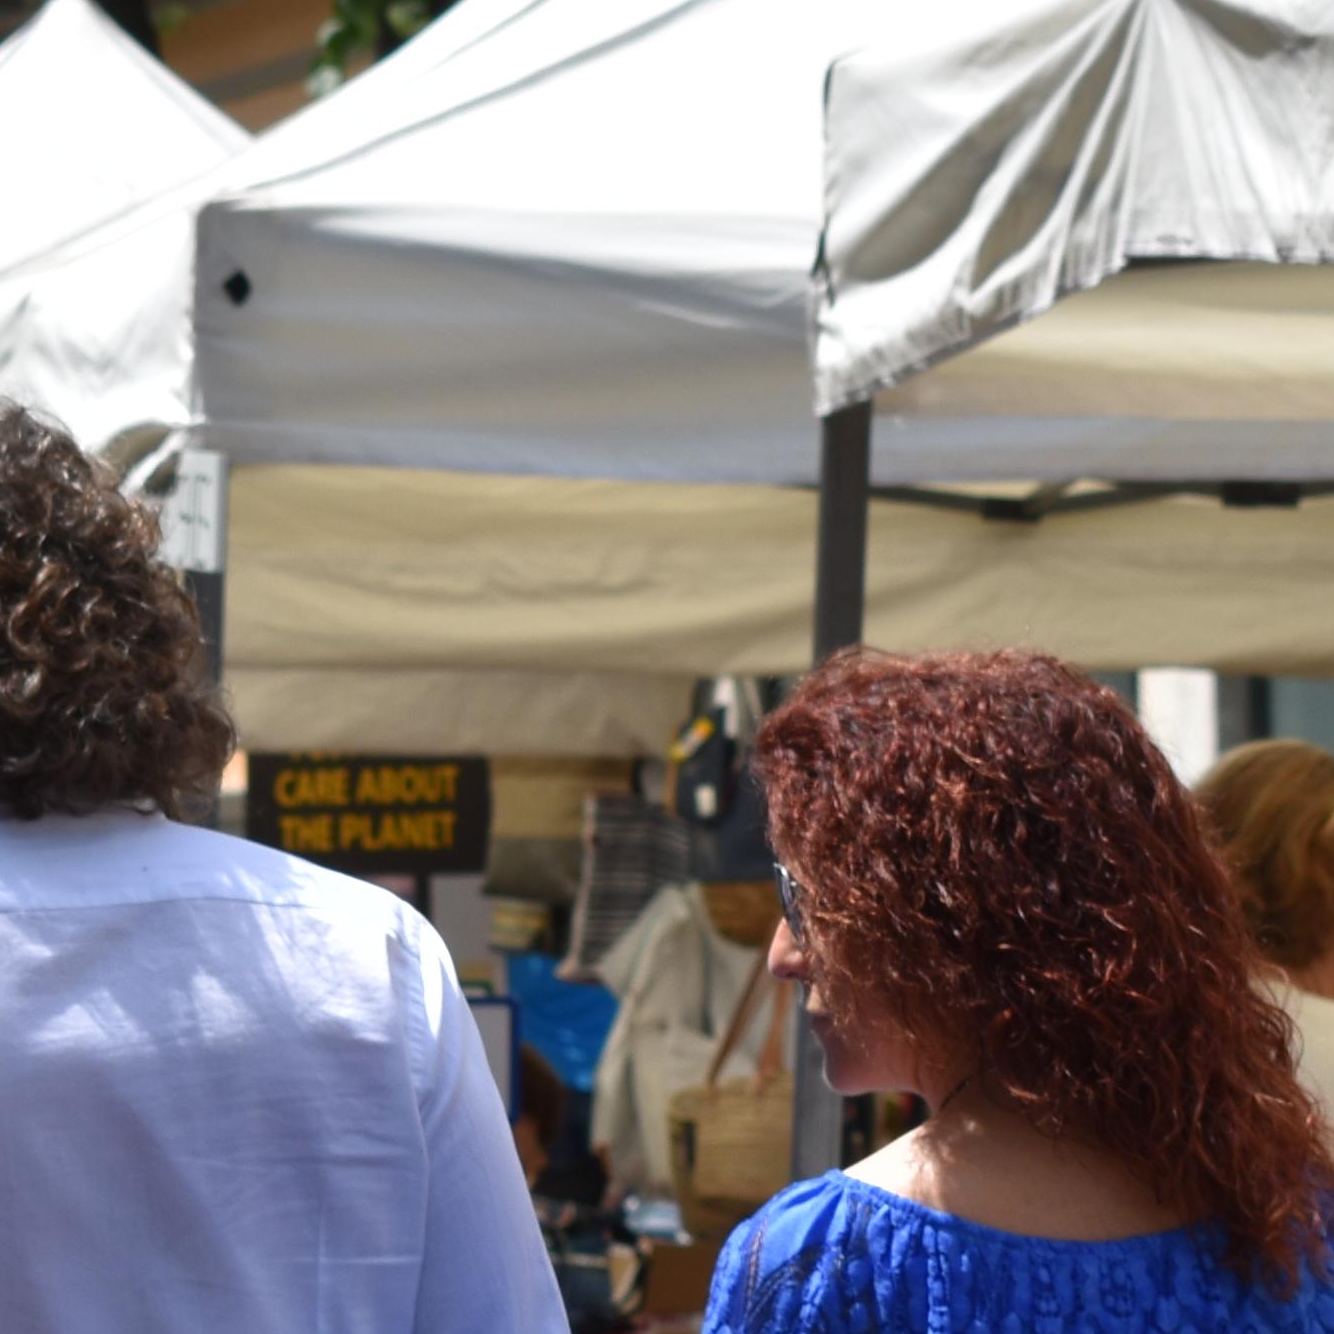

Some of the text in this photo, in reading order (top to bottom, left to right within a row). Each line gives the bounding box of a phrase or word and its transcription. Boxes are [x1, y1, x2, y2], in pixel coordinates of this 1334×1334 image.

[275, 765, 459, 808] CARE ABOUT
[280, 811, 455, 853] THE PLANET
